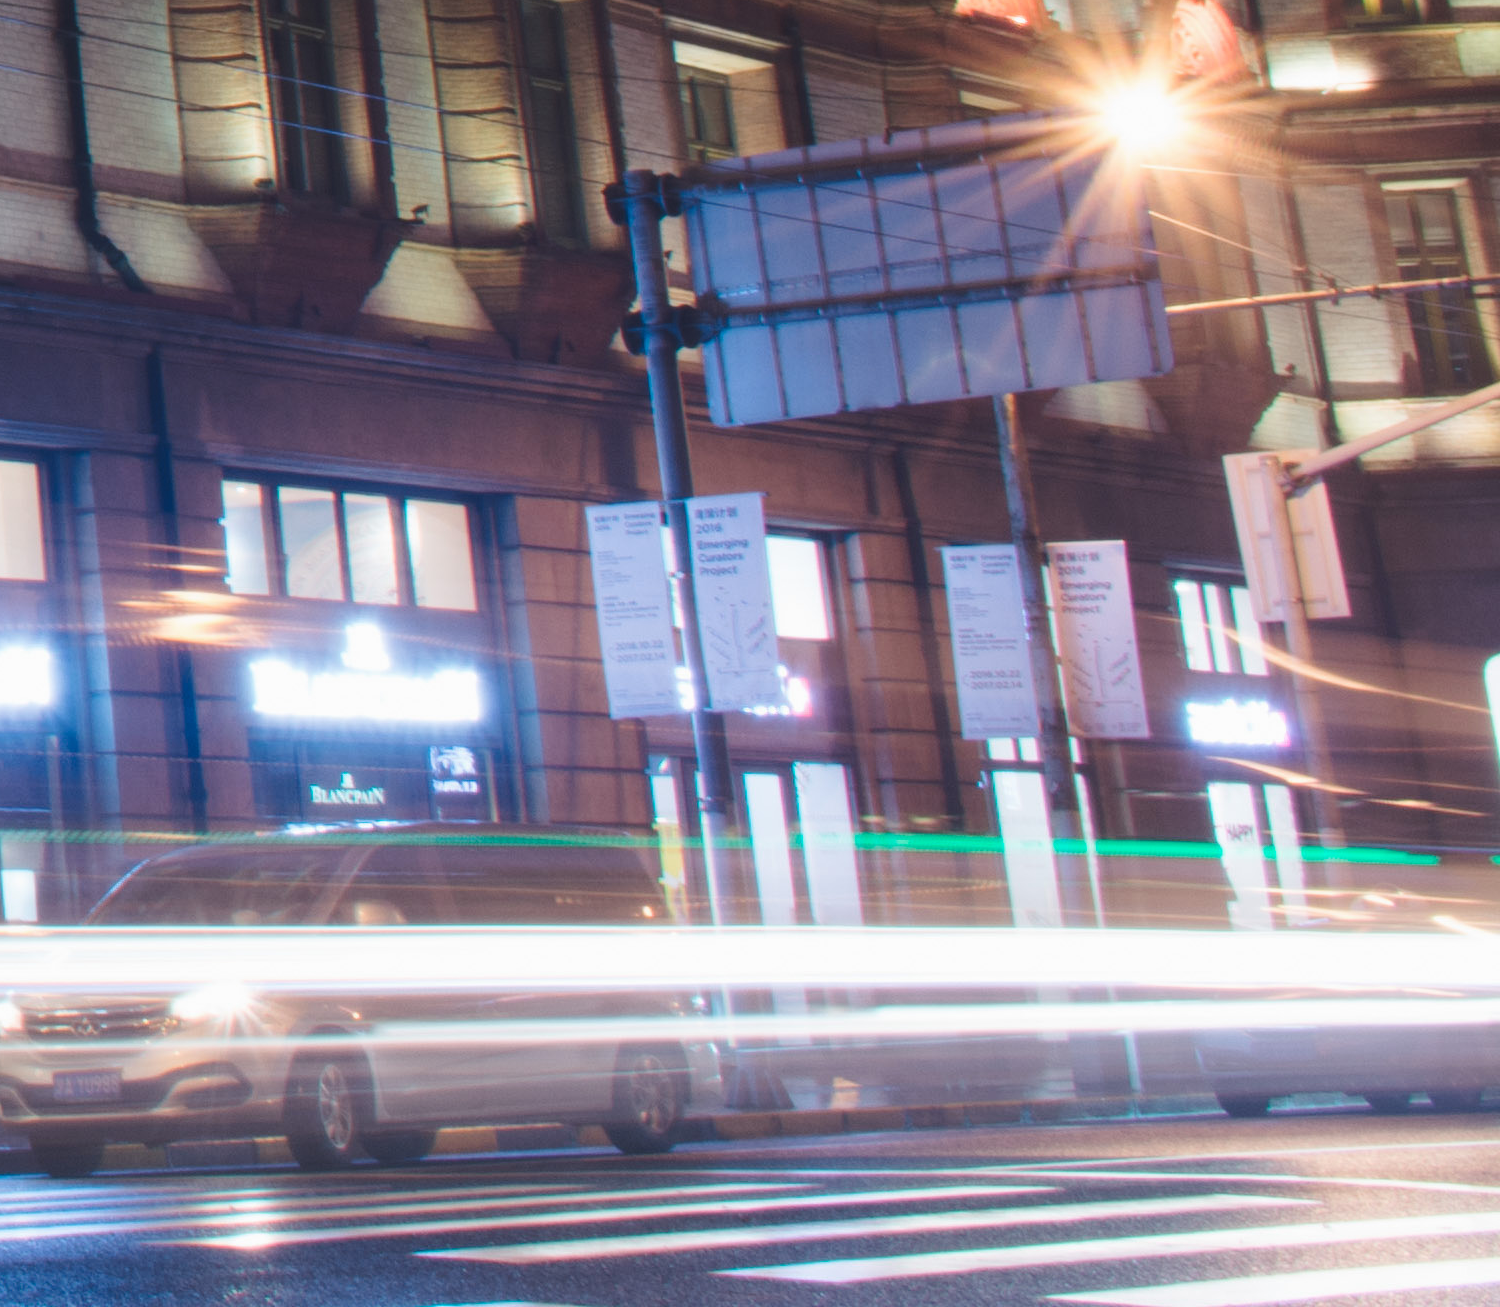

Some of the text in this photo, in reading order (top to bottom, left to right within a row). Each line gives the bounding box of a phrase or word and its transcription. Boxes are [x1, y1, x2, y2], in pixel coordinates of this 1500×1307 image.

[695, 523, 723, 534] 2016
[697, 538, 750, 551] Emerging
[698, 552, 744, 563] Curators
[699, 565, 738, 577] Project
[1058, 565, 1085, 575] 2016
[1059, 581, 1112, 591] Emerging
[1060, 593, 1107, 602] Curators
[1061, 605, 1100, 614] Project
[310, 784, 385, 804] BLANCPAIN
